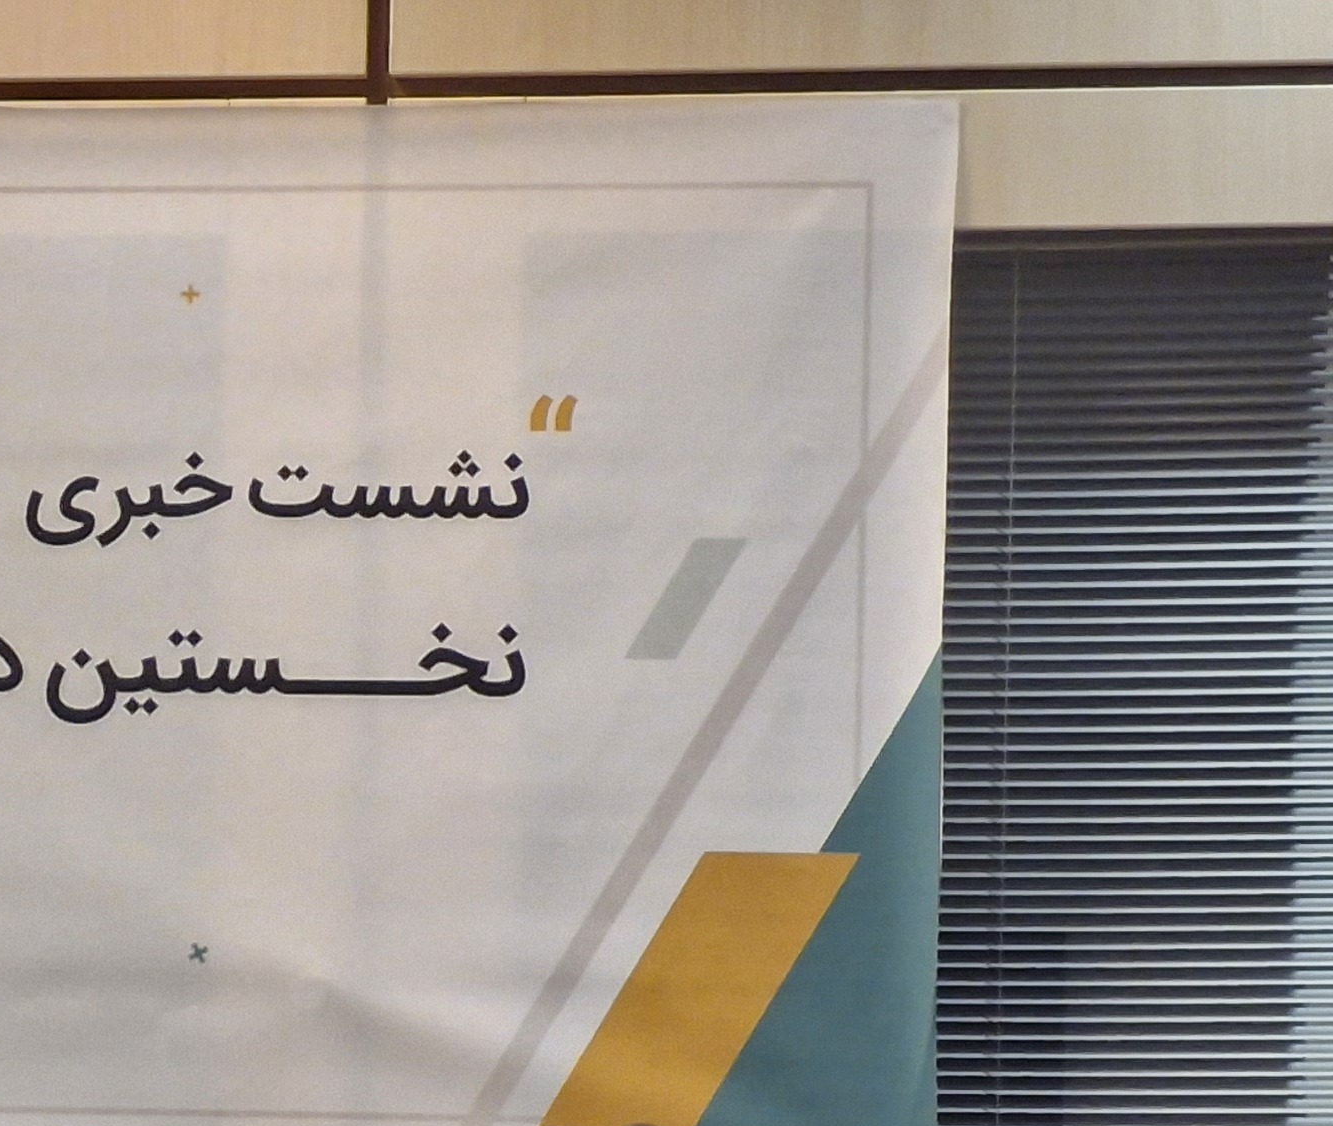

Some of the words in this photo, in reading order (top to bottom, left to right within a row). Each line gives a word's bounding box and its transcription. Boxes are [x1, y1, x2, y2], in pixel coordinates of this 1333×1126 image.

[24, 451, 234, 547] خبری
[247, 449, 530, 520] نشست
[45, 622, 527, 725] نخستین
